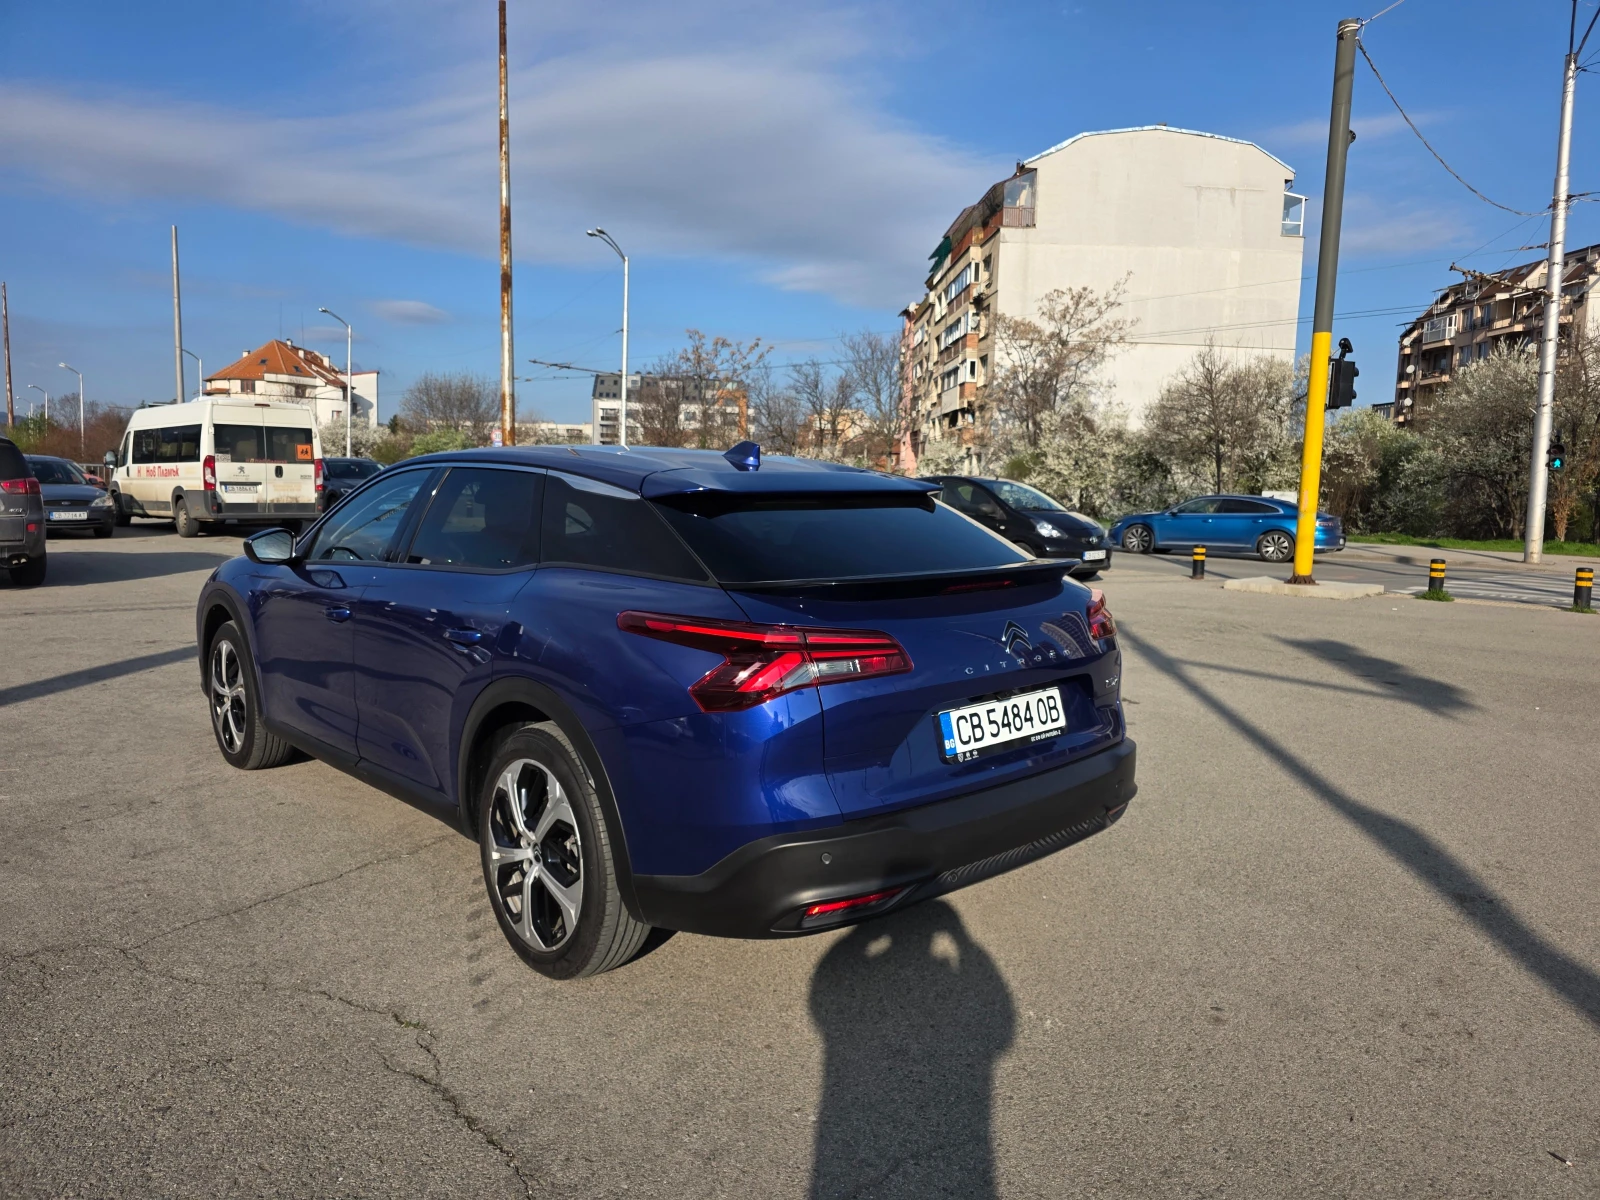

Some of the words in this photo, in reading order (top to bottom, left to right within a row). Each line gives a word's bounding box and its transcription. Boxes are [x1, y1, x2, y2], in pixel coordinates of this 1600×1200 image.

[956, 712, 985, 746] CB
[986, 700, 1035, 738] 5484
[1036, 695, 1060, 726] OB
[944, 738, 956, 750] BG
